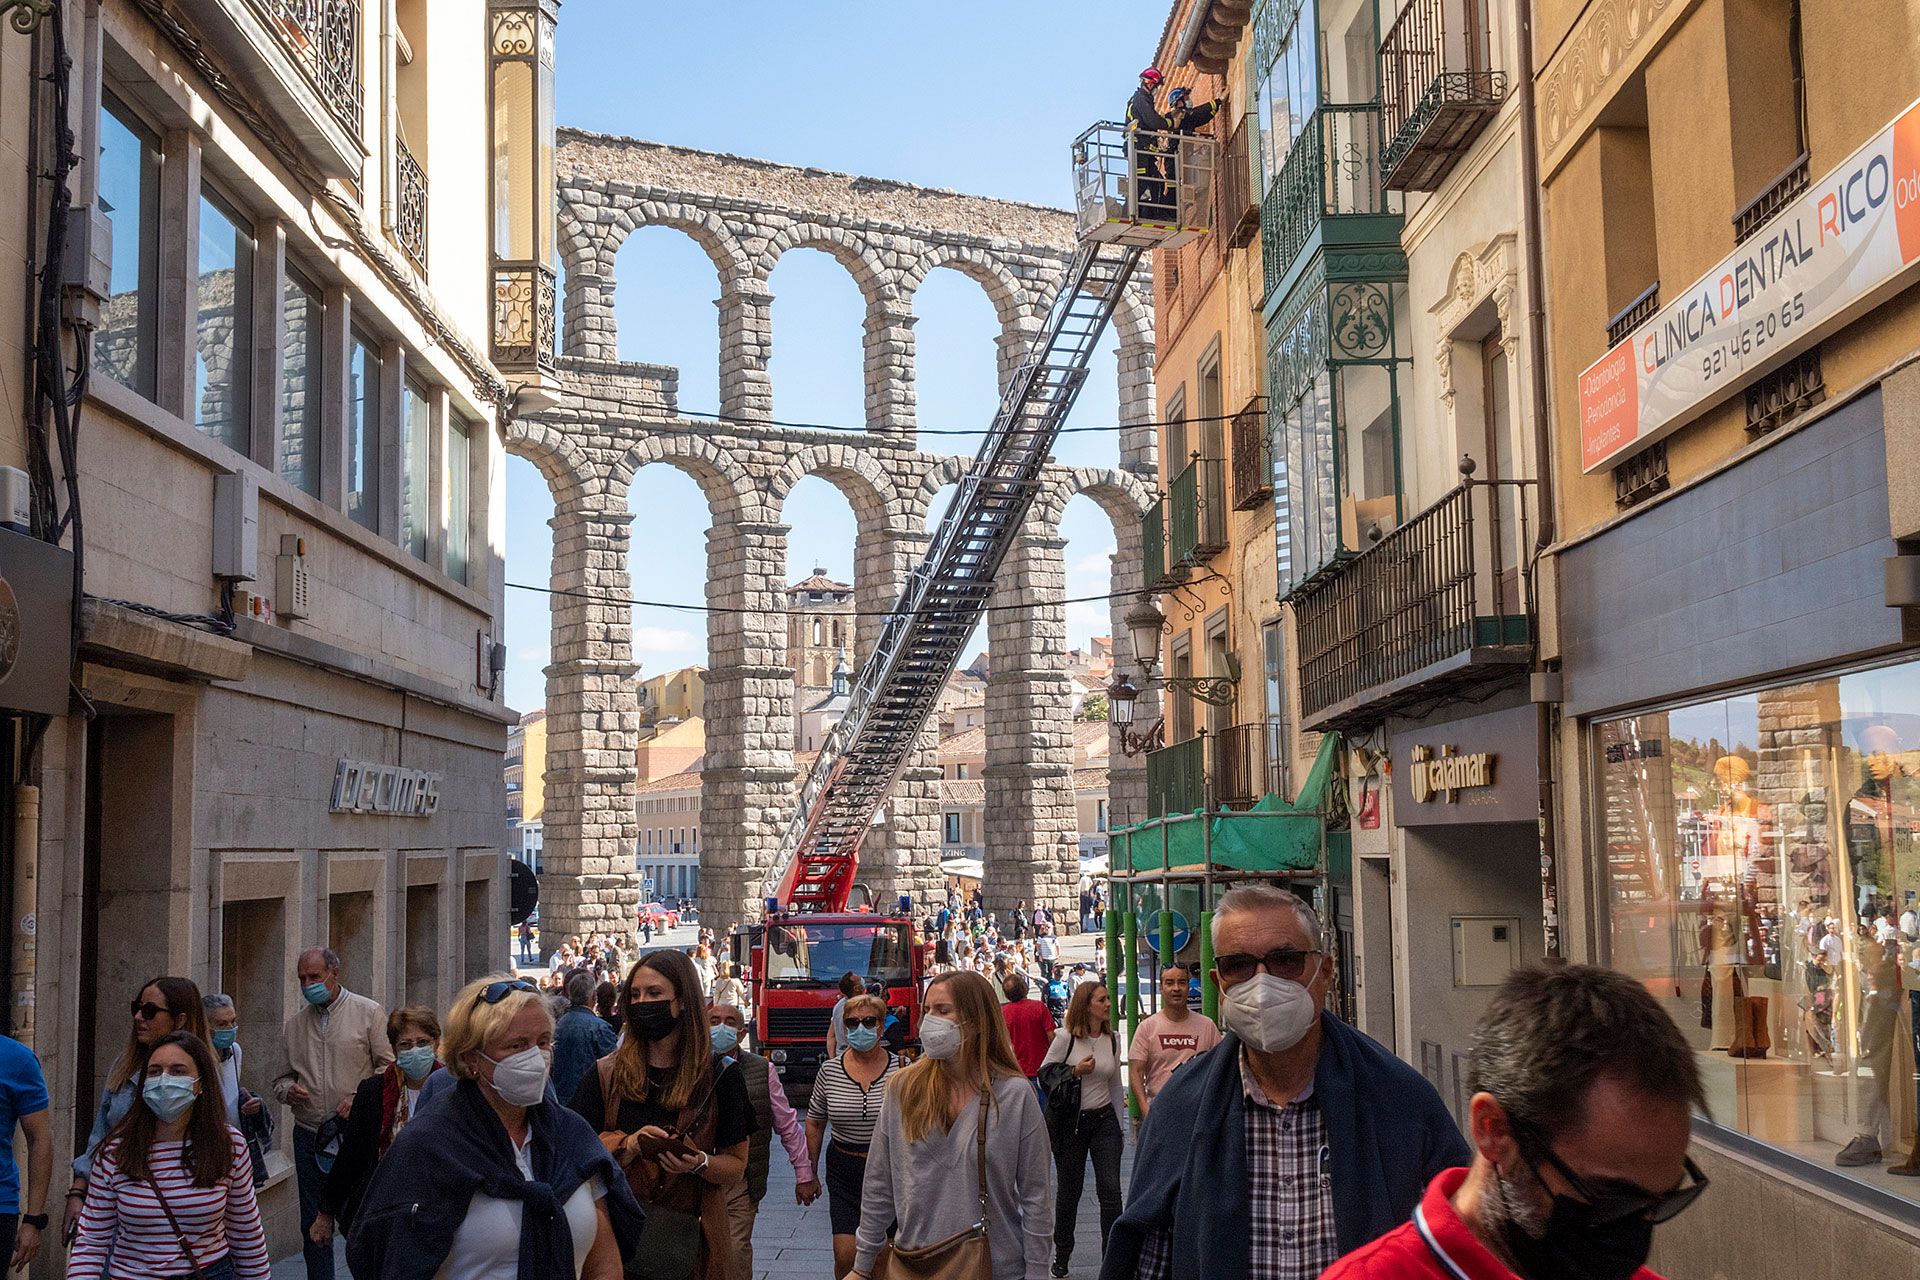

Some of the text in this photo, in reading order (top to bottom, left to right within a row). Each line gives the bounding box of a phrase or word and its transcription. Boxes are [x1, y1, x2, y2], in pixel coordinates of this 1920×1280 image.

[1643, 153, 1889, 375] CLINICA DENTAL RICO
[1702, 291, 1804, 381] 921 46 20 65
[331, 758, 443, 815] DECIMAS
[1428, 744, 1488, 804] cajamar
[945, 849, 966, 857] KING
